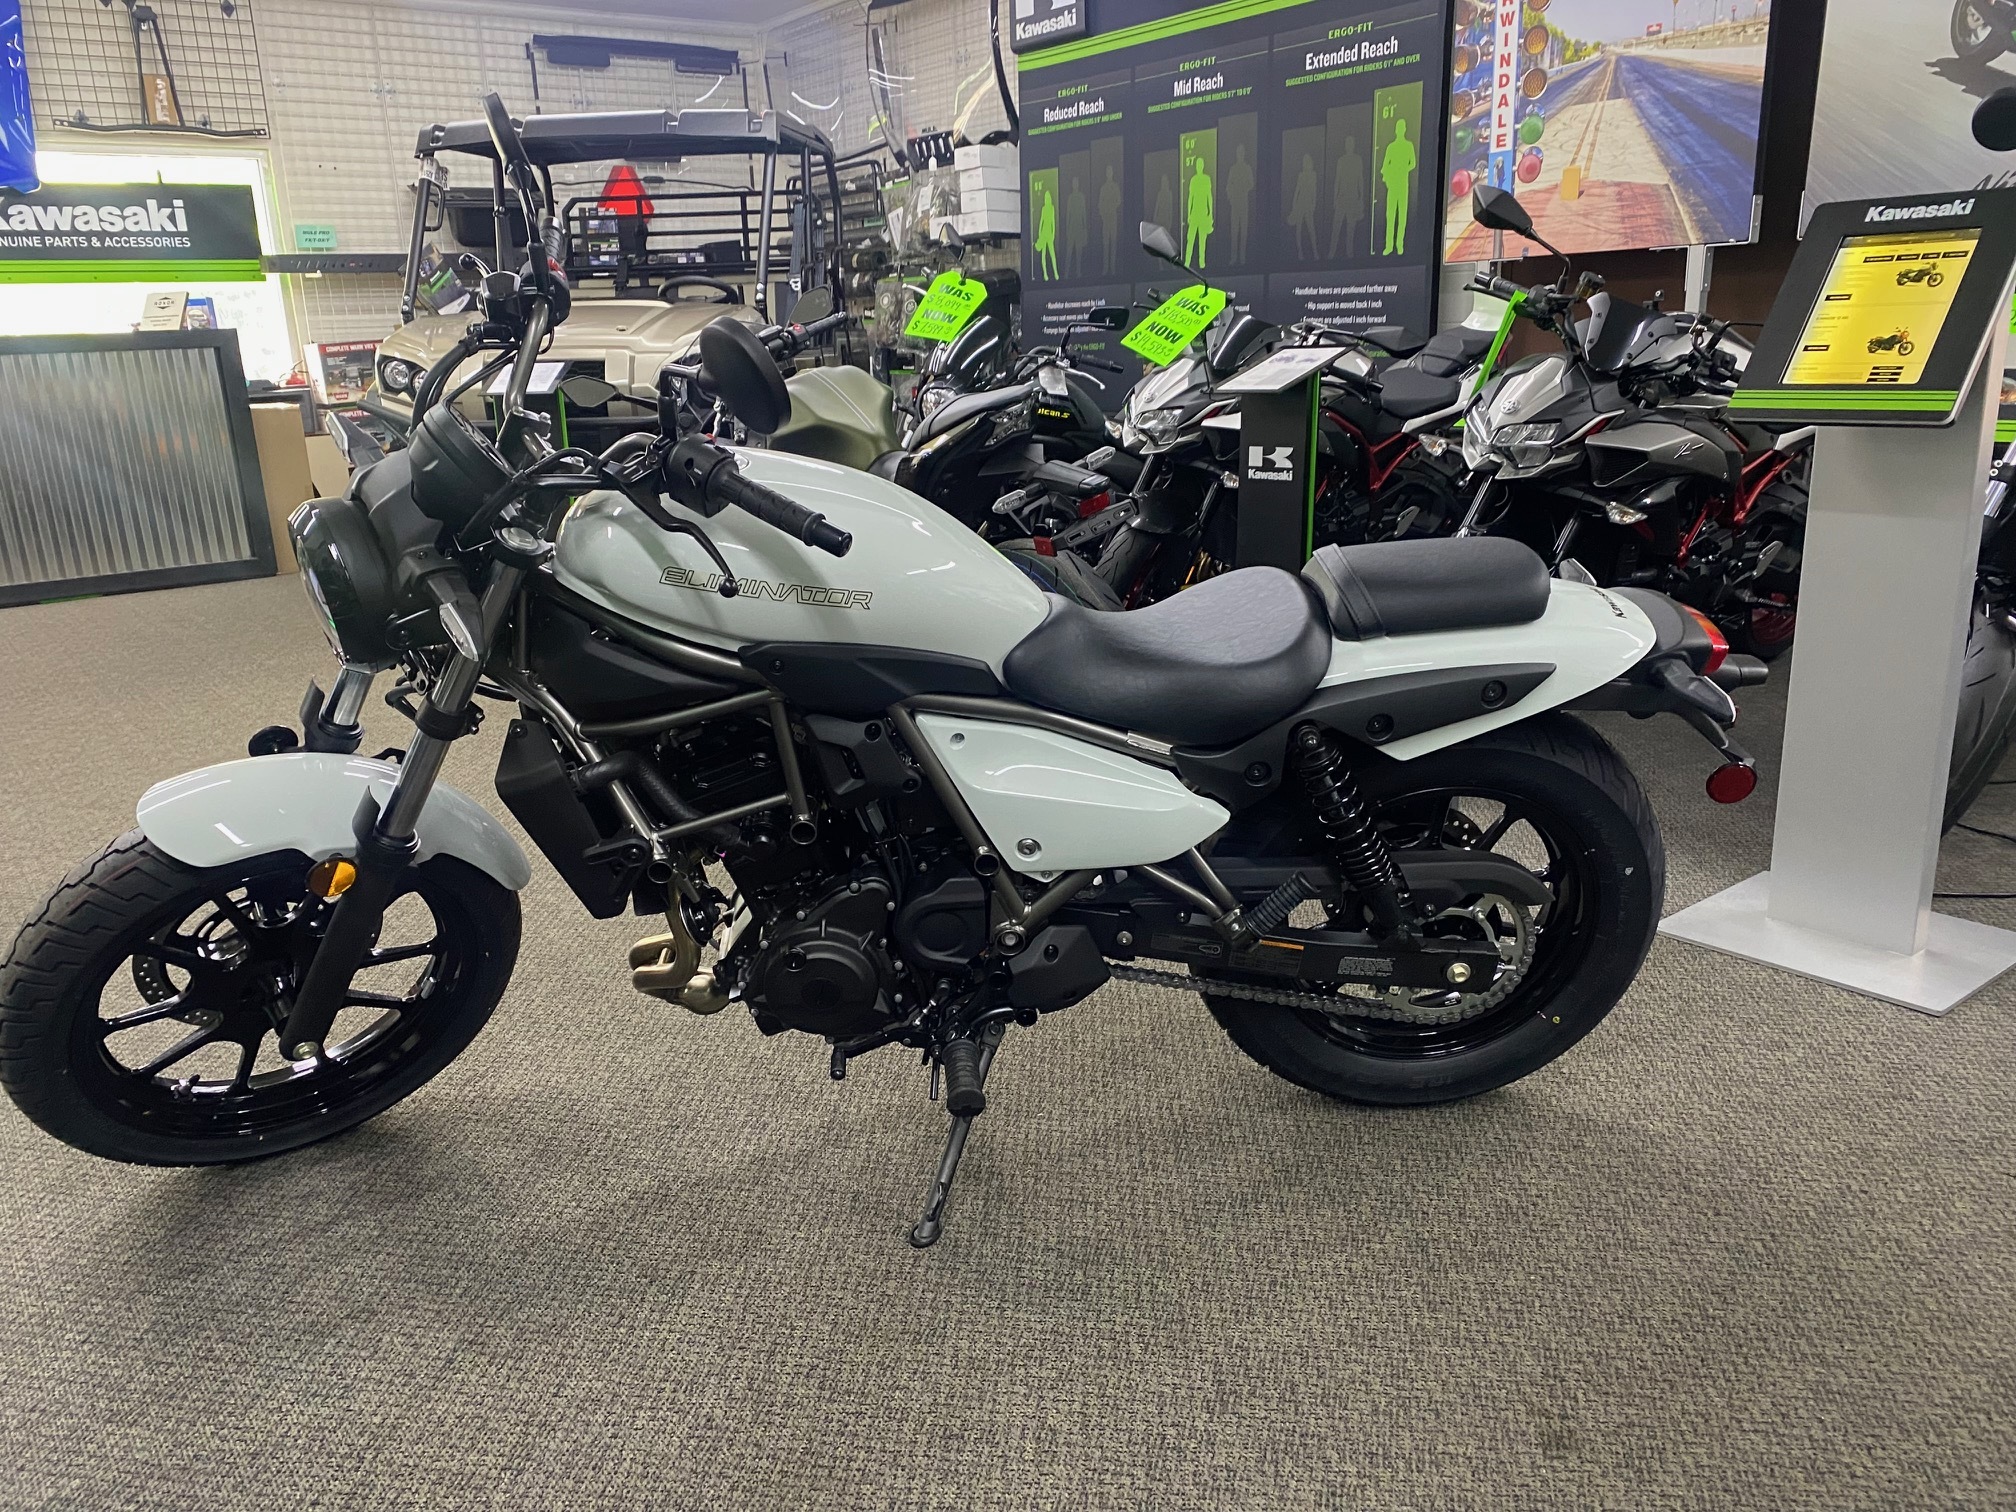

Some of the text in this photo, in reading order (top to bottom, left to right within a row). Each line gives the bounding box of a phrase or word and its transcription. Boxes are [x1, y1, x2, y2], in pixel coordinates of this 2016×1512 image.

[1015, 8, 1077, 40] Kawasaki
[1328, 21, 1374, 39] ERGO-FIT
[1305, 35, 1399, 70] Extended Reach
[1180, 56, 1216, 71] ERGO-FIT
[1353, 65, 1363, 74] FOR
[1364, 61, 1383, 72] RIDERS
[1393, 56, 1405, 66] AND
[1405, 53, 1420, 64] OVER
[1057, 84, 1088, 98] ERGO-FIT
[1174, 72, 1224, 97] Mid Reach
[1044, 97, 1104, 123] Reduced Reach
[1864, 198, 1975, 222] Kawasaki
[45, 236, 88, 248] PARTS
[90, 236, 101, 248] &
[104, 236, 191, 248] ACCESSORIES
[939, 283, 974, 301] WAS
[1175, 296, 1209, 316] WAS
[922, 308, 958, 325] NOW
[1145, 321, 1183, 345] NOW
[326, 343, 349, 352] COMPLETE
[1248, 468, 1293, 481] Kawasaki
